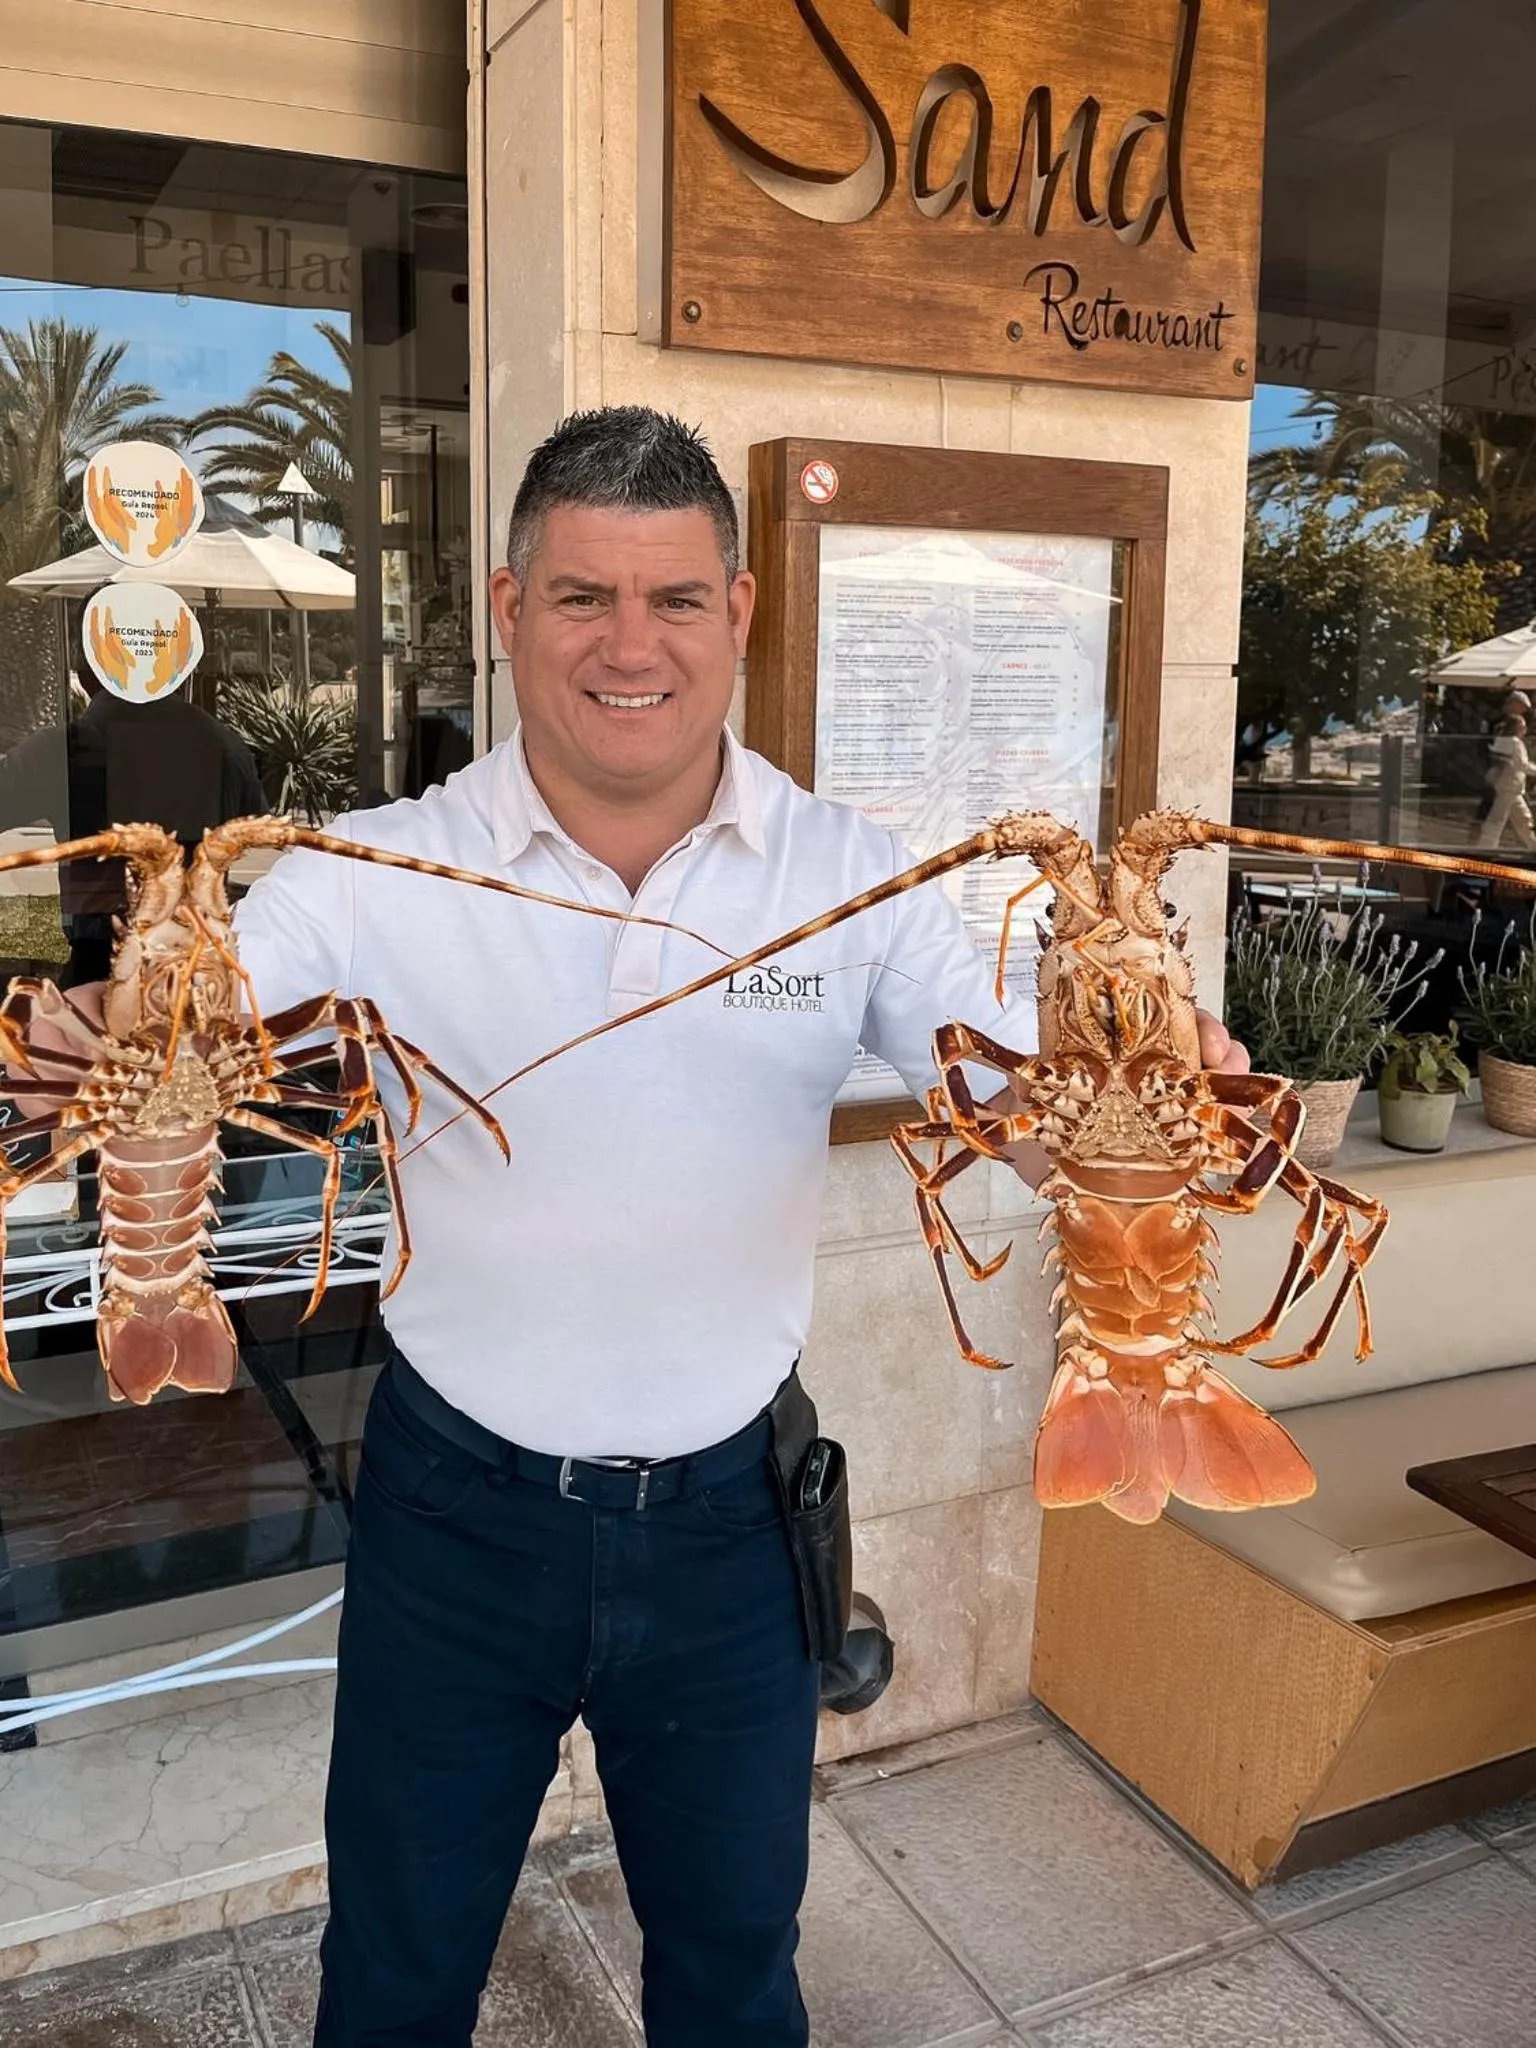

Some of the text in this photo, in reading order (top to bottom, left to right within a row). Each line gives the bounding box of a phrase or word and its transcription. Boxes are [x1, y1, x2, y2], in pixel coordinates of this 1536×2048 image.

[699, 0, 1197, 253] Sand
[1023, 262, 1235, 351] Restaurant
[109, 488, 180, 500] RECOMENDADO
[141, 502, 169, 511] Repsol
[135, 511, 155, 519] 2024
[109, 627, 179, 638] RECOMENDADO
[140, 640, 167, 648] Repsol
[725, 965, 825, 998] LaSort
[723, 994, 824, 1013] BOUTIQUE HOTEL
